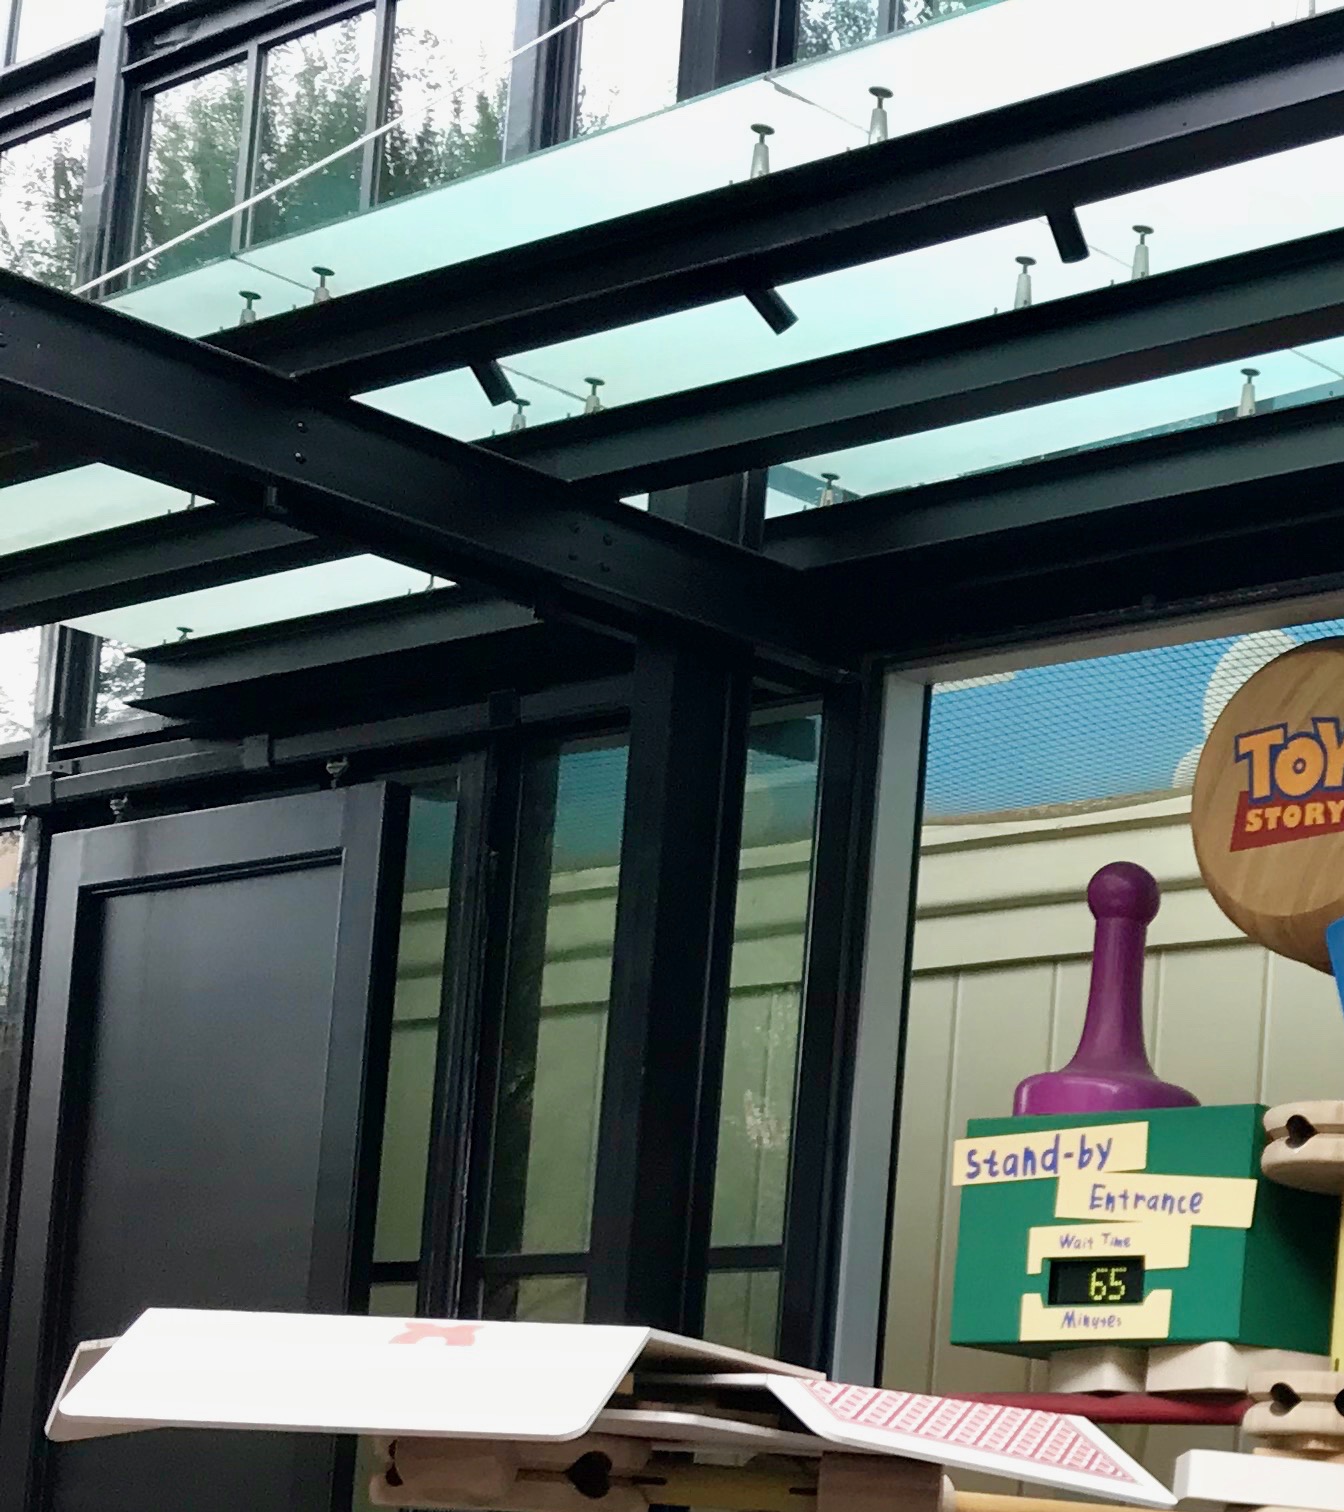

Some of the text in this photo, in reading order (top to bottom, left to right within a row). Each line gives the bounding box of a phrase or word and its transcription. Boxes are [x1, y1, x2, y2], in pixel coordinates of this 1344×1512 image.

[966, 1133, 1112, 1180] Stand-by
[1089, 1183, 1203, 1214] Entrance
[1059, 1232, 1131, 1249] Wait Time
[1089, 1267, 1127, 1301] 65
[1061, 1311, 1122, 1329] Minutes
